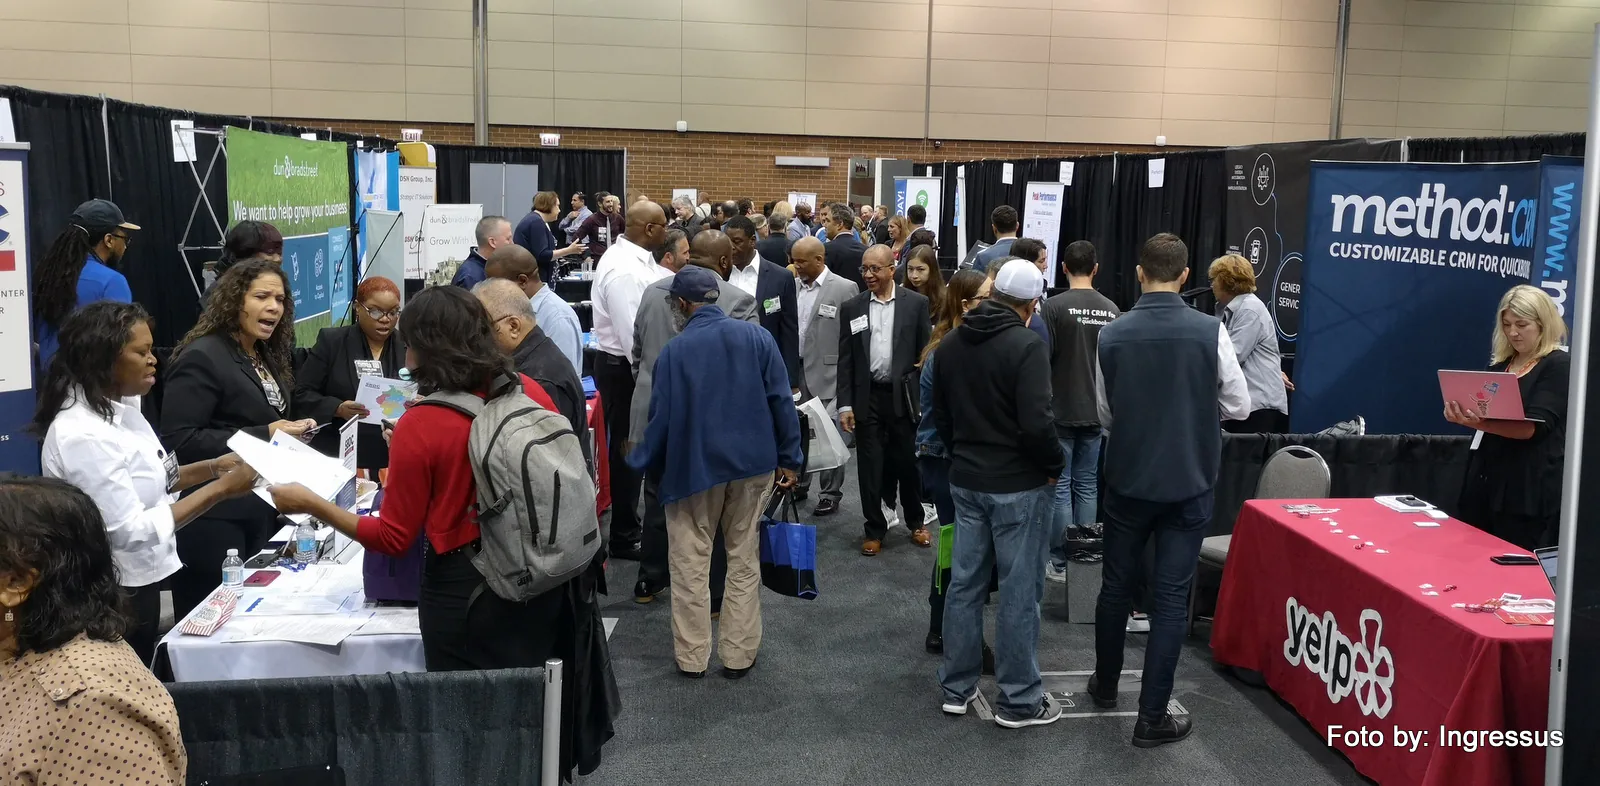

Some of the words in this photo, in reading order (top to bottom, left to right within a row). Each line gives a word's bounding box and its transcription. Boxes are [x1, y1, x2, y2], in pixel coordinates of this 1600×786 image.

[404, 131, 420, 141] EXIT
[543, 136, 558, 146] EXIT
[233, 200, 247, 221] We
[248, 204, 268, 221] want
[269, 204, 277, 220] to
[278, 200, 293, 226] help
[294, 206, 310, 225] grow
[310, 206, 325, 224] your
[325, 200, 348, 217] business
[429, 236, 450, 246] Grow
[451, 235, 470, 245] With
[1329, 242, 1447, 267] CUSTOMIZABLE
[1449, 250, 1476, 269] CRM
[1477, 254, 1498, 273] FOR
[1280, 281, 1301, 294] GENER
[1, 290, 25, 298] NTER
[1278, 297, 1300, 310] SERVIC
[1068, 307, 1082, 315] The
[1082, 308, 1090, 316] #1
[1091, 309, 1107, 317] CRM
[1107, 311, 1117, 319] for
[1287, 603, 1353, 697] yelp
